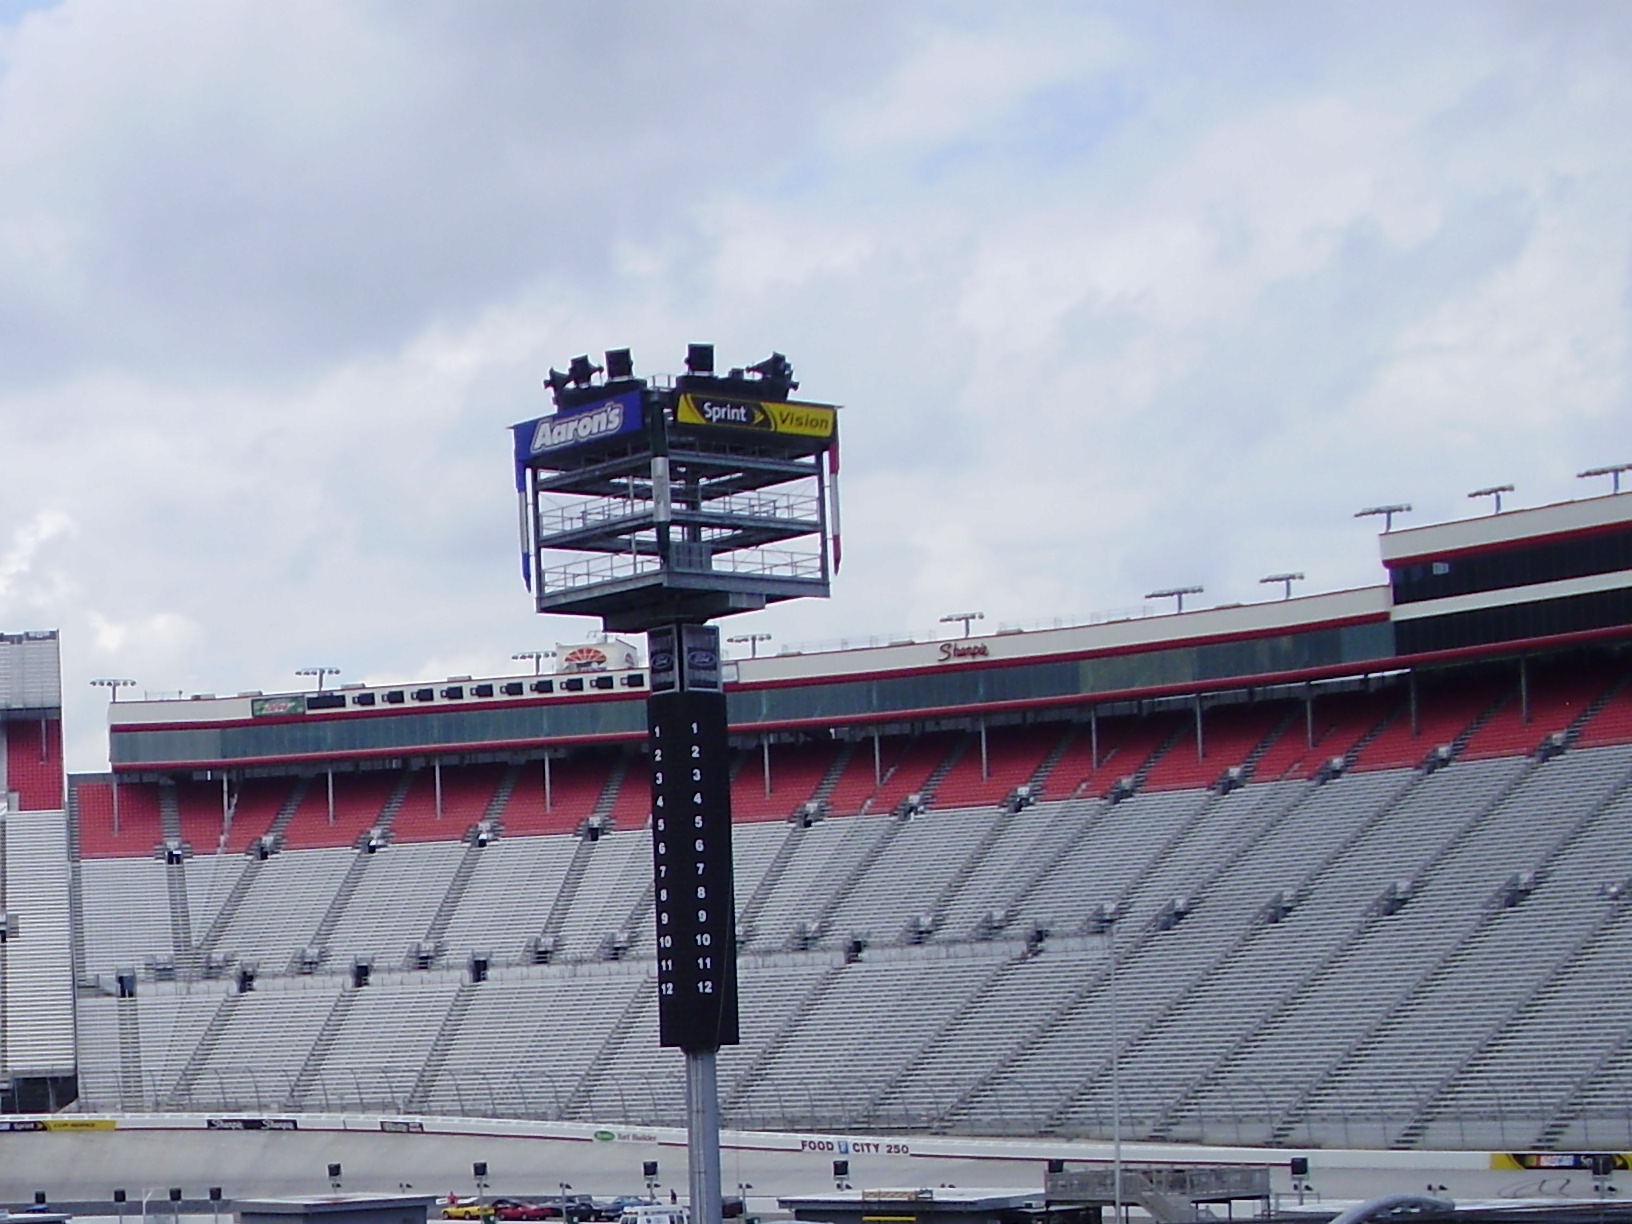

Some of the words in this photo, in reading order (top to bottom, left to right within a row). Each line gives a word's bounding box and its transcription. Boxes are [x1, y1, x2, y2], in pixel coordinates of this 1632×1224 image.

[702, 401, 748, 424] Sprint
[779, 410, 829, 430] Vision
[531, 402, 624, 454] Aaron's
[654, 726, 660, 738] 1
[691, 722, 698, 734] 1
[654, 748, 662, 762] 2
[691, 745, 700, 758] 2
[655, 772, 663, 785] 3
[692, 768, 701, 781] 3
[656, 795, 664, 808] 4
[693, 792, 702, 804] 4
[657, 818, 665, 831] 5
[694, 815, 703, 828] 5
[658, 842, 666, 855] 6
[695, 839, 704, 852] 6
[659, 865, 667, 878] 7
[696, 862, 705, 875] 7
[660, 888, 668, 902] 8
[697, 886, 706, 899] 8
[661, 912, 669, 925] 9
[697, 909, 707, 923] 9
[659, 935, 672, 948] 10
[695, 933, 711, 946] 10
[661, 959, 672, 971] 11
[697, 957, 711, 970] 11
[661, 982, 674, 995] 12
[697, 980, 713, 993] 12
[801, 1140, 835, 1151] FOOD
[852, 1142, 880, 1153] CITY
[886, 1144, 910, 1154] 250
